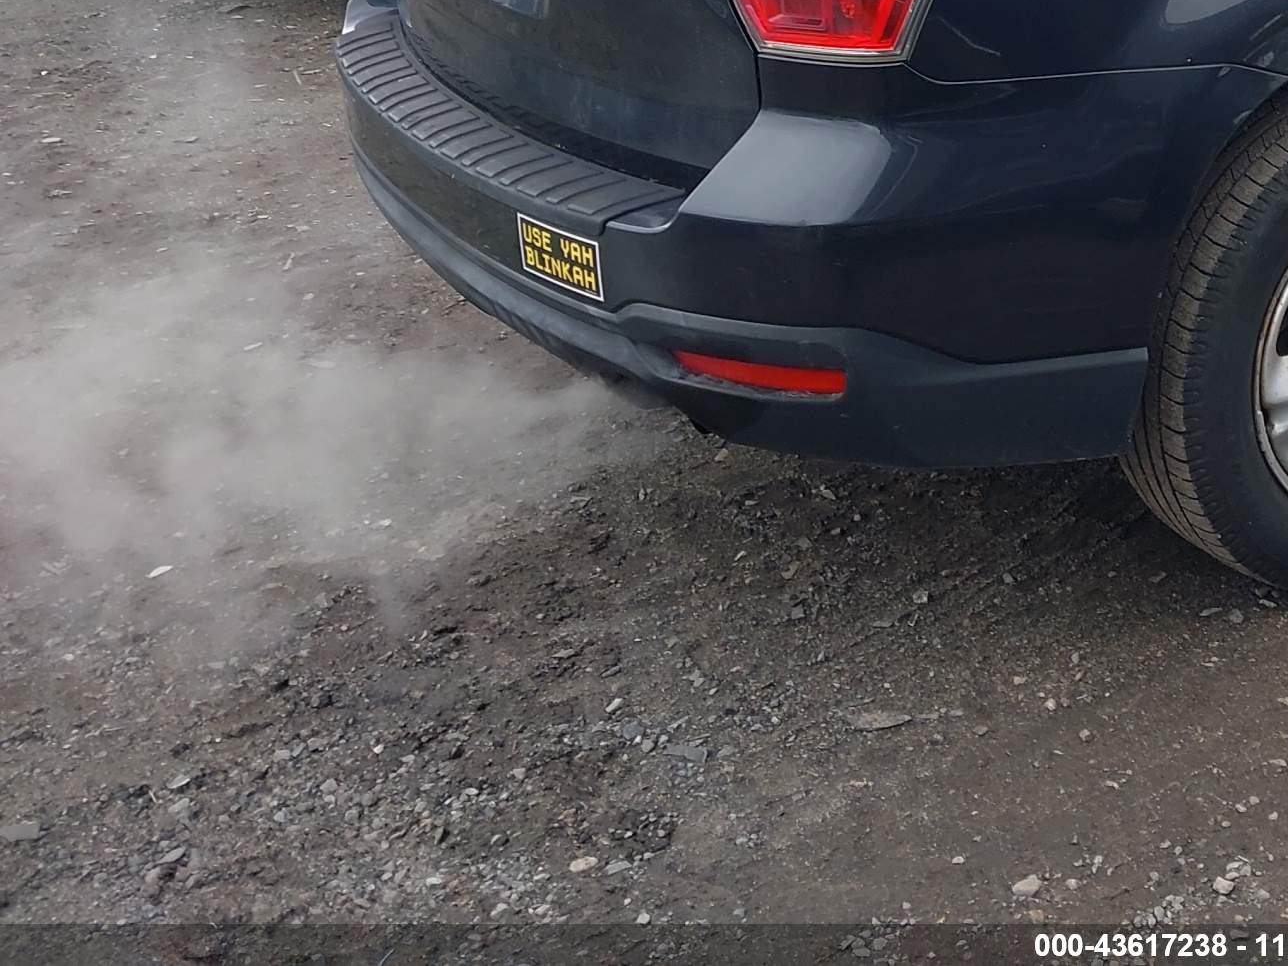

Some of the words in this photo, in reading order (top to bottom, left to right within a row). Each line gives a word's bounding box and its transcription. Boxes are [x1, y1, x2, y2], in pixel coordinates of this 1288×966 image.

[522, 222, 553, 253] USE
[560, 238, 595, 268] YAH
[525, 245, 597, 291] BLINKAH
